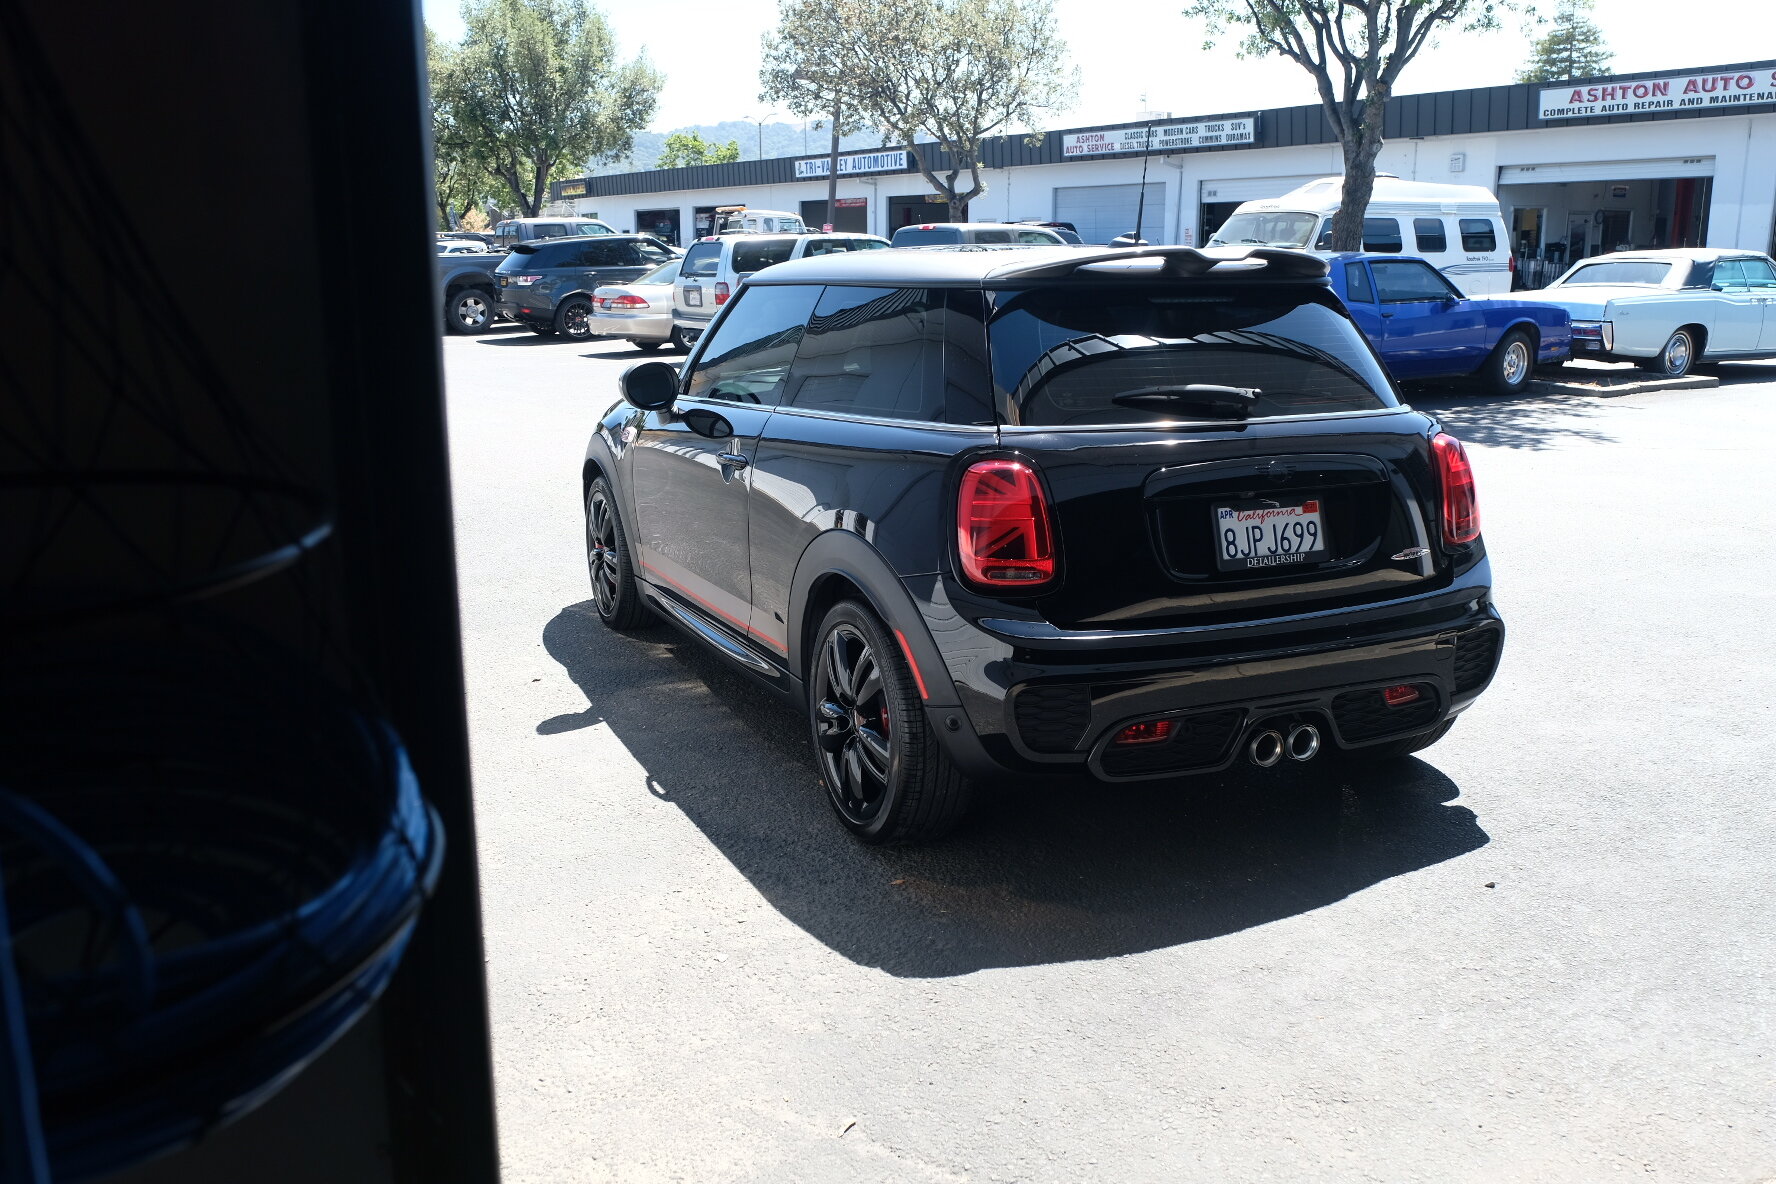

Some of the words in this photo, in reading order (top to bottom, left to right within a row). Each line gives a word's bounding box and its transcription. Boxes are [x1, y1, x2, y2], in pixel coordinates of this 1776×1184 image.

[1569, 81, 1670, 104] ASHTON
[1683, 74, 1755, 95] AUTO
[1543, 105, 1595, 117] COMPLETE
[1601, 102, 1628, 113] AUTO
[1634, 99, 1673, 110] REPAIR
[1680, 97, 1703, 107] AND
[1709, 91, 1776, 104] MAINTENA
[1076, 133, 1105, 144] ASHTON
[1124, 131, 1144, 140] CLASSIC
[1163, 127, 1184, 137] MODERN
[1185, 125, 1199, 135] CARS
[1204, 123, 1225, 133] TRUCKS
[1065, 145, 1084, 154] AUTO
[1087, 142, 1115, 153] SERVICE
[1120, 141, 1135, 150] DIESEL
[1159, 136, 1193, 147] POWERSTROKE
[1198, 134, 1222, 144] CUMMINS
[1225, 132, 1251, 142] DURAMAX
[804, 157, 848, 175] TRI-VAEY
[852, 152, 904, 171] AUTOMOTIVE
[1219, 509, 1234, 520] APR
[1237, 508, 1303, 524] California
[1224, 520, 1318, 559] 8JPJ699
[1247, 553, 1305, 567] DETAILERSHIP
